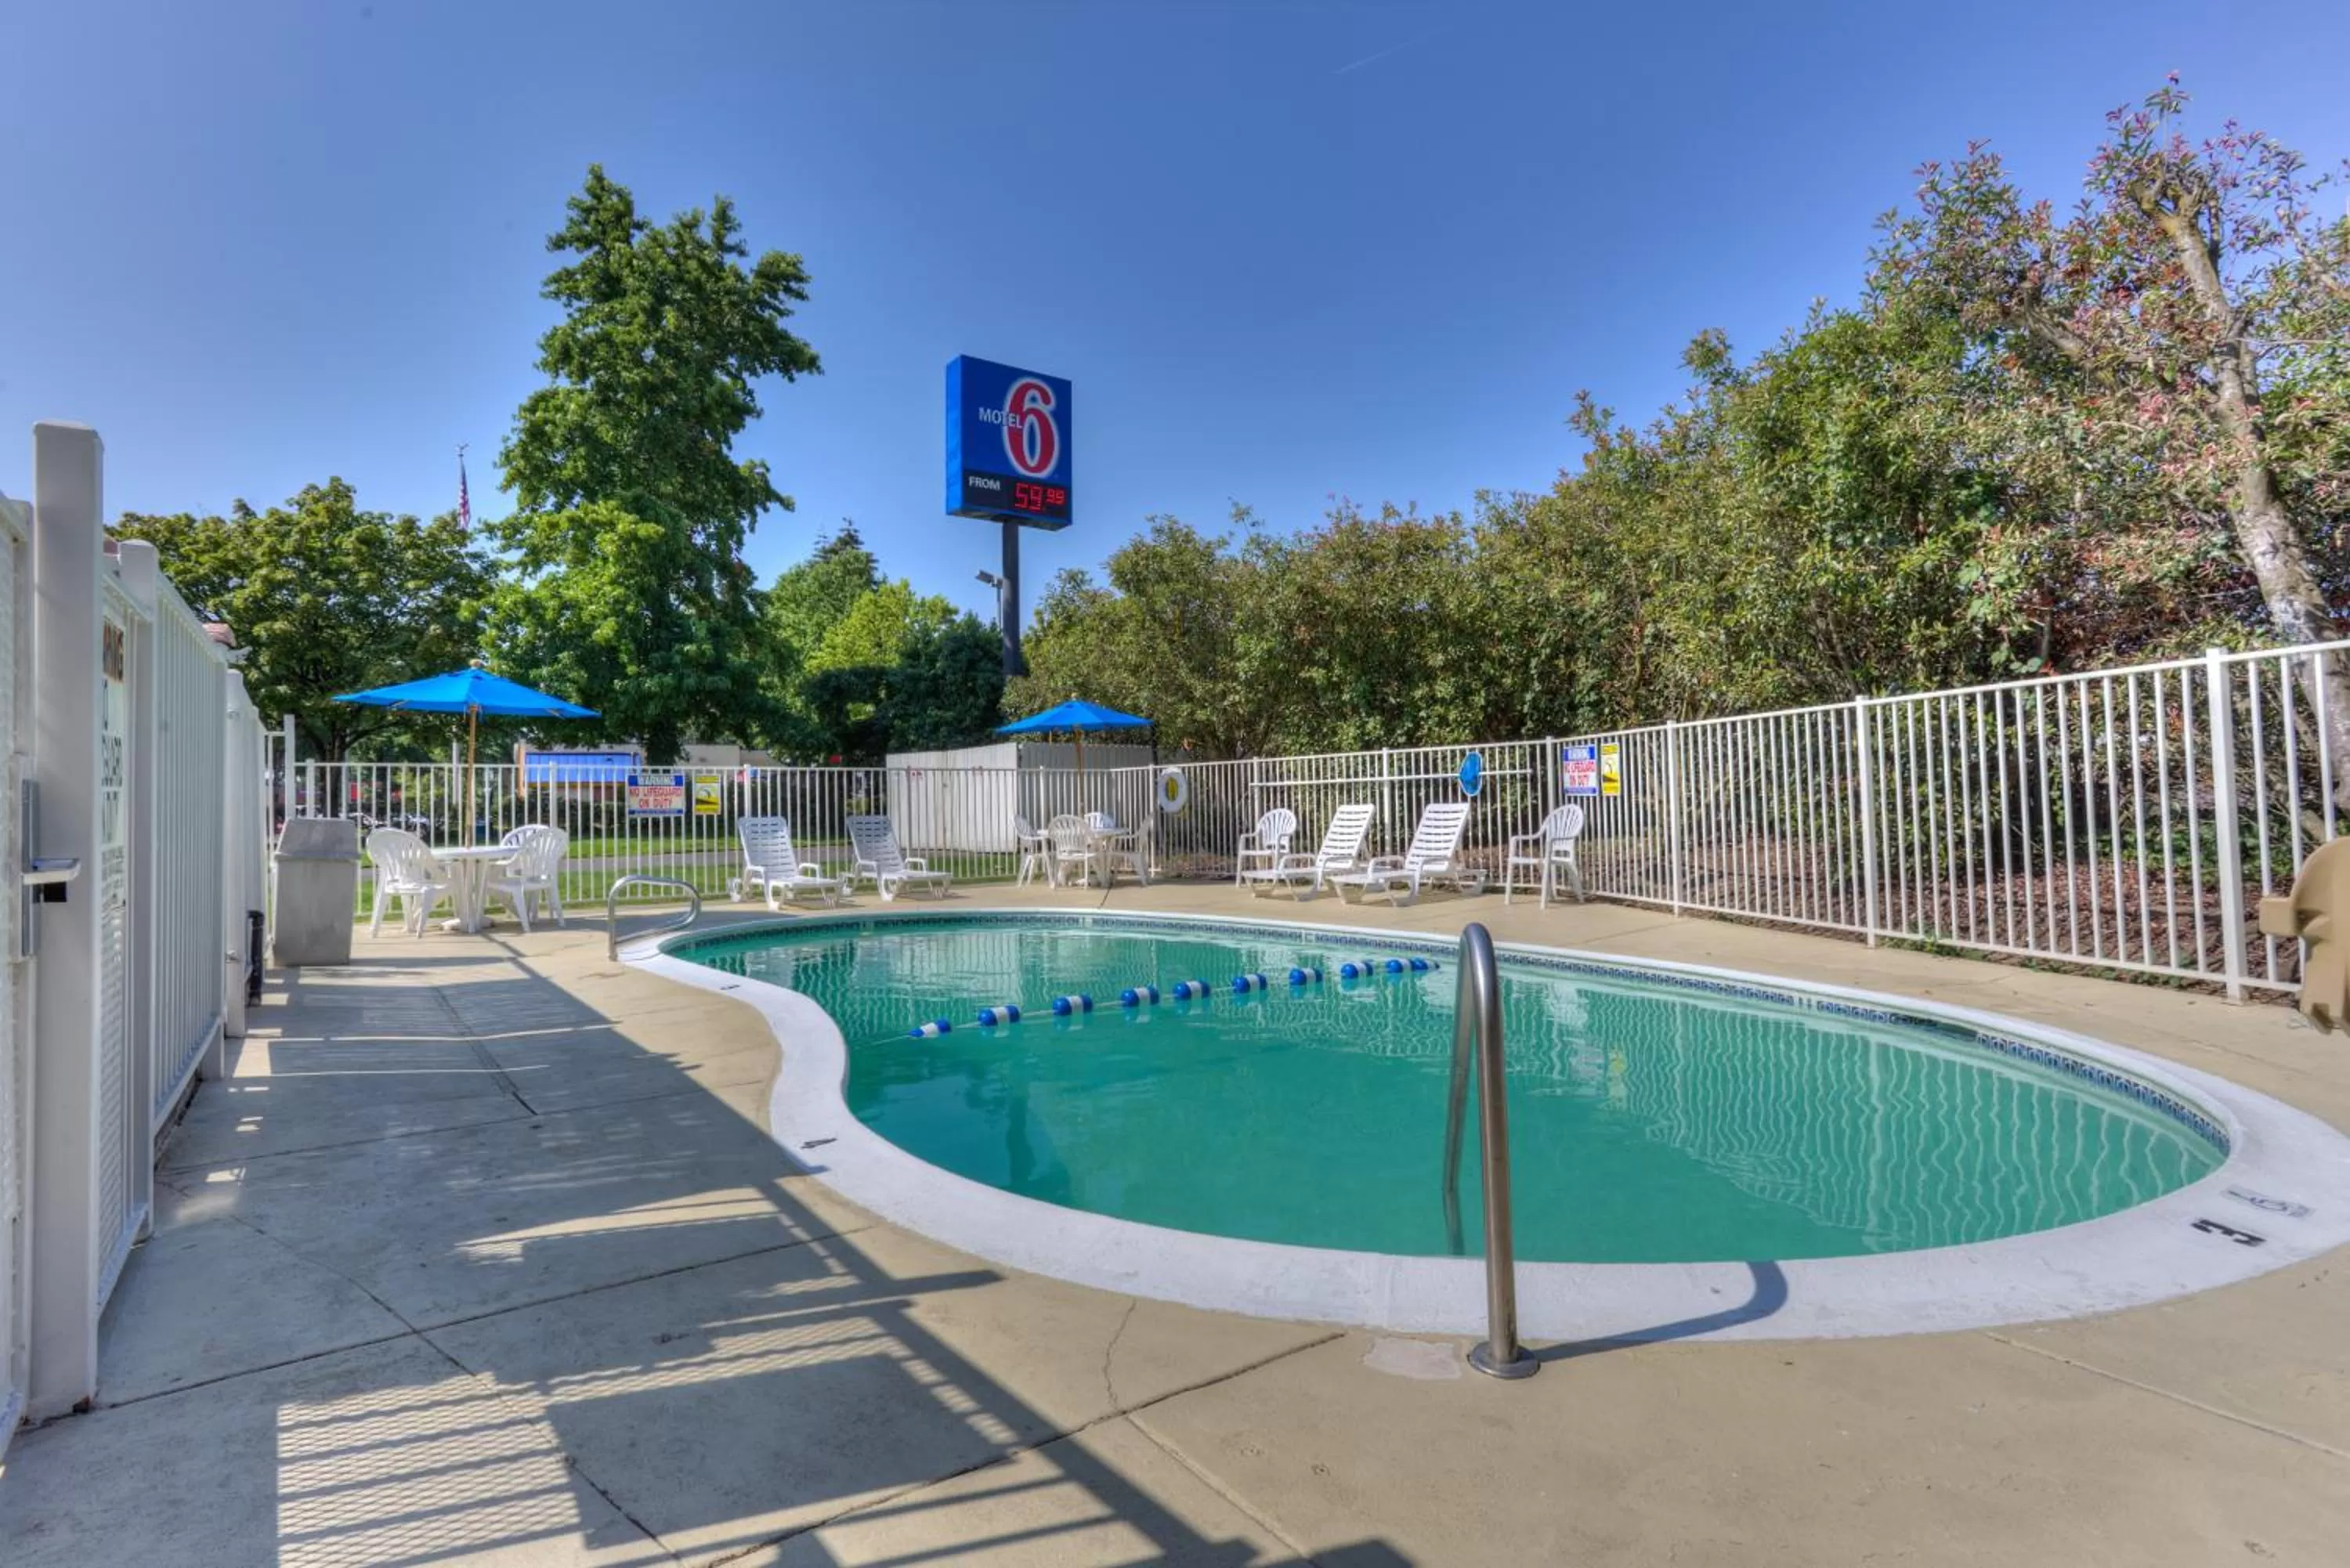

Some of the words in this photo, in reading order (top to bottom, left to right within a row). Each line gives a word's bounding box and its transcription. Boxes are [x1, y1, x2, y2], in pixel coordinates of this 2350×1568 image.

[978, 406, 1024, 429] MOTEL
[1002, 377, 1059, 478] 6
[968, 475, 1001, 490] FROM
[629, 787, 640, 797] NO
[643, 786, 682, 797] LIFEGUARD
[639, 798, 649, 808] ON
[654, 798, 672, 808] DUTY
